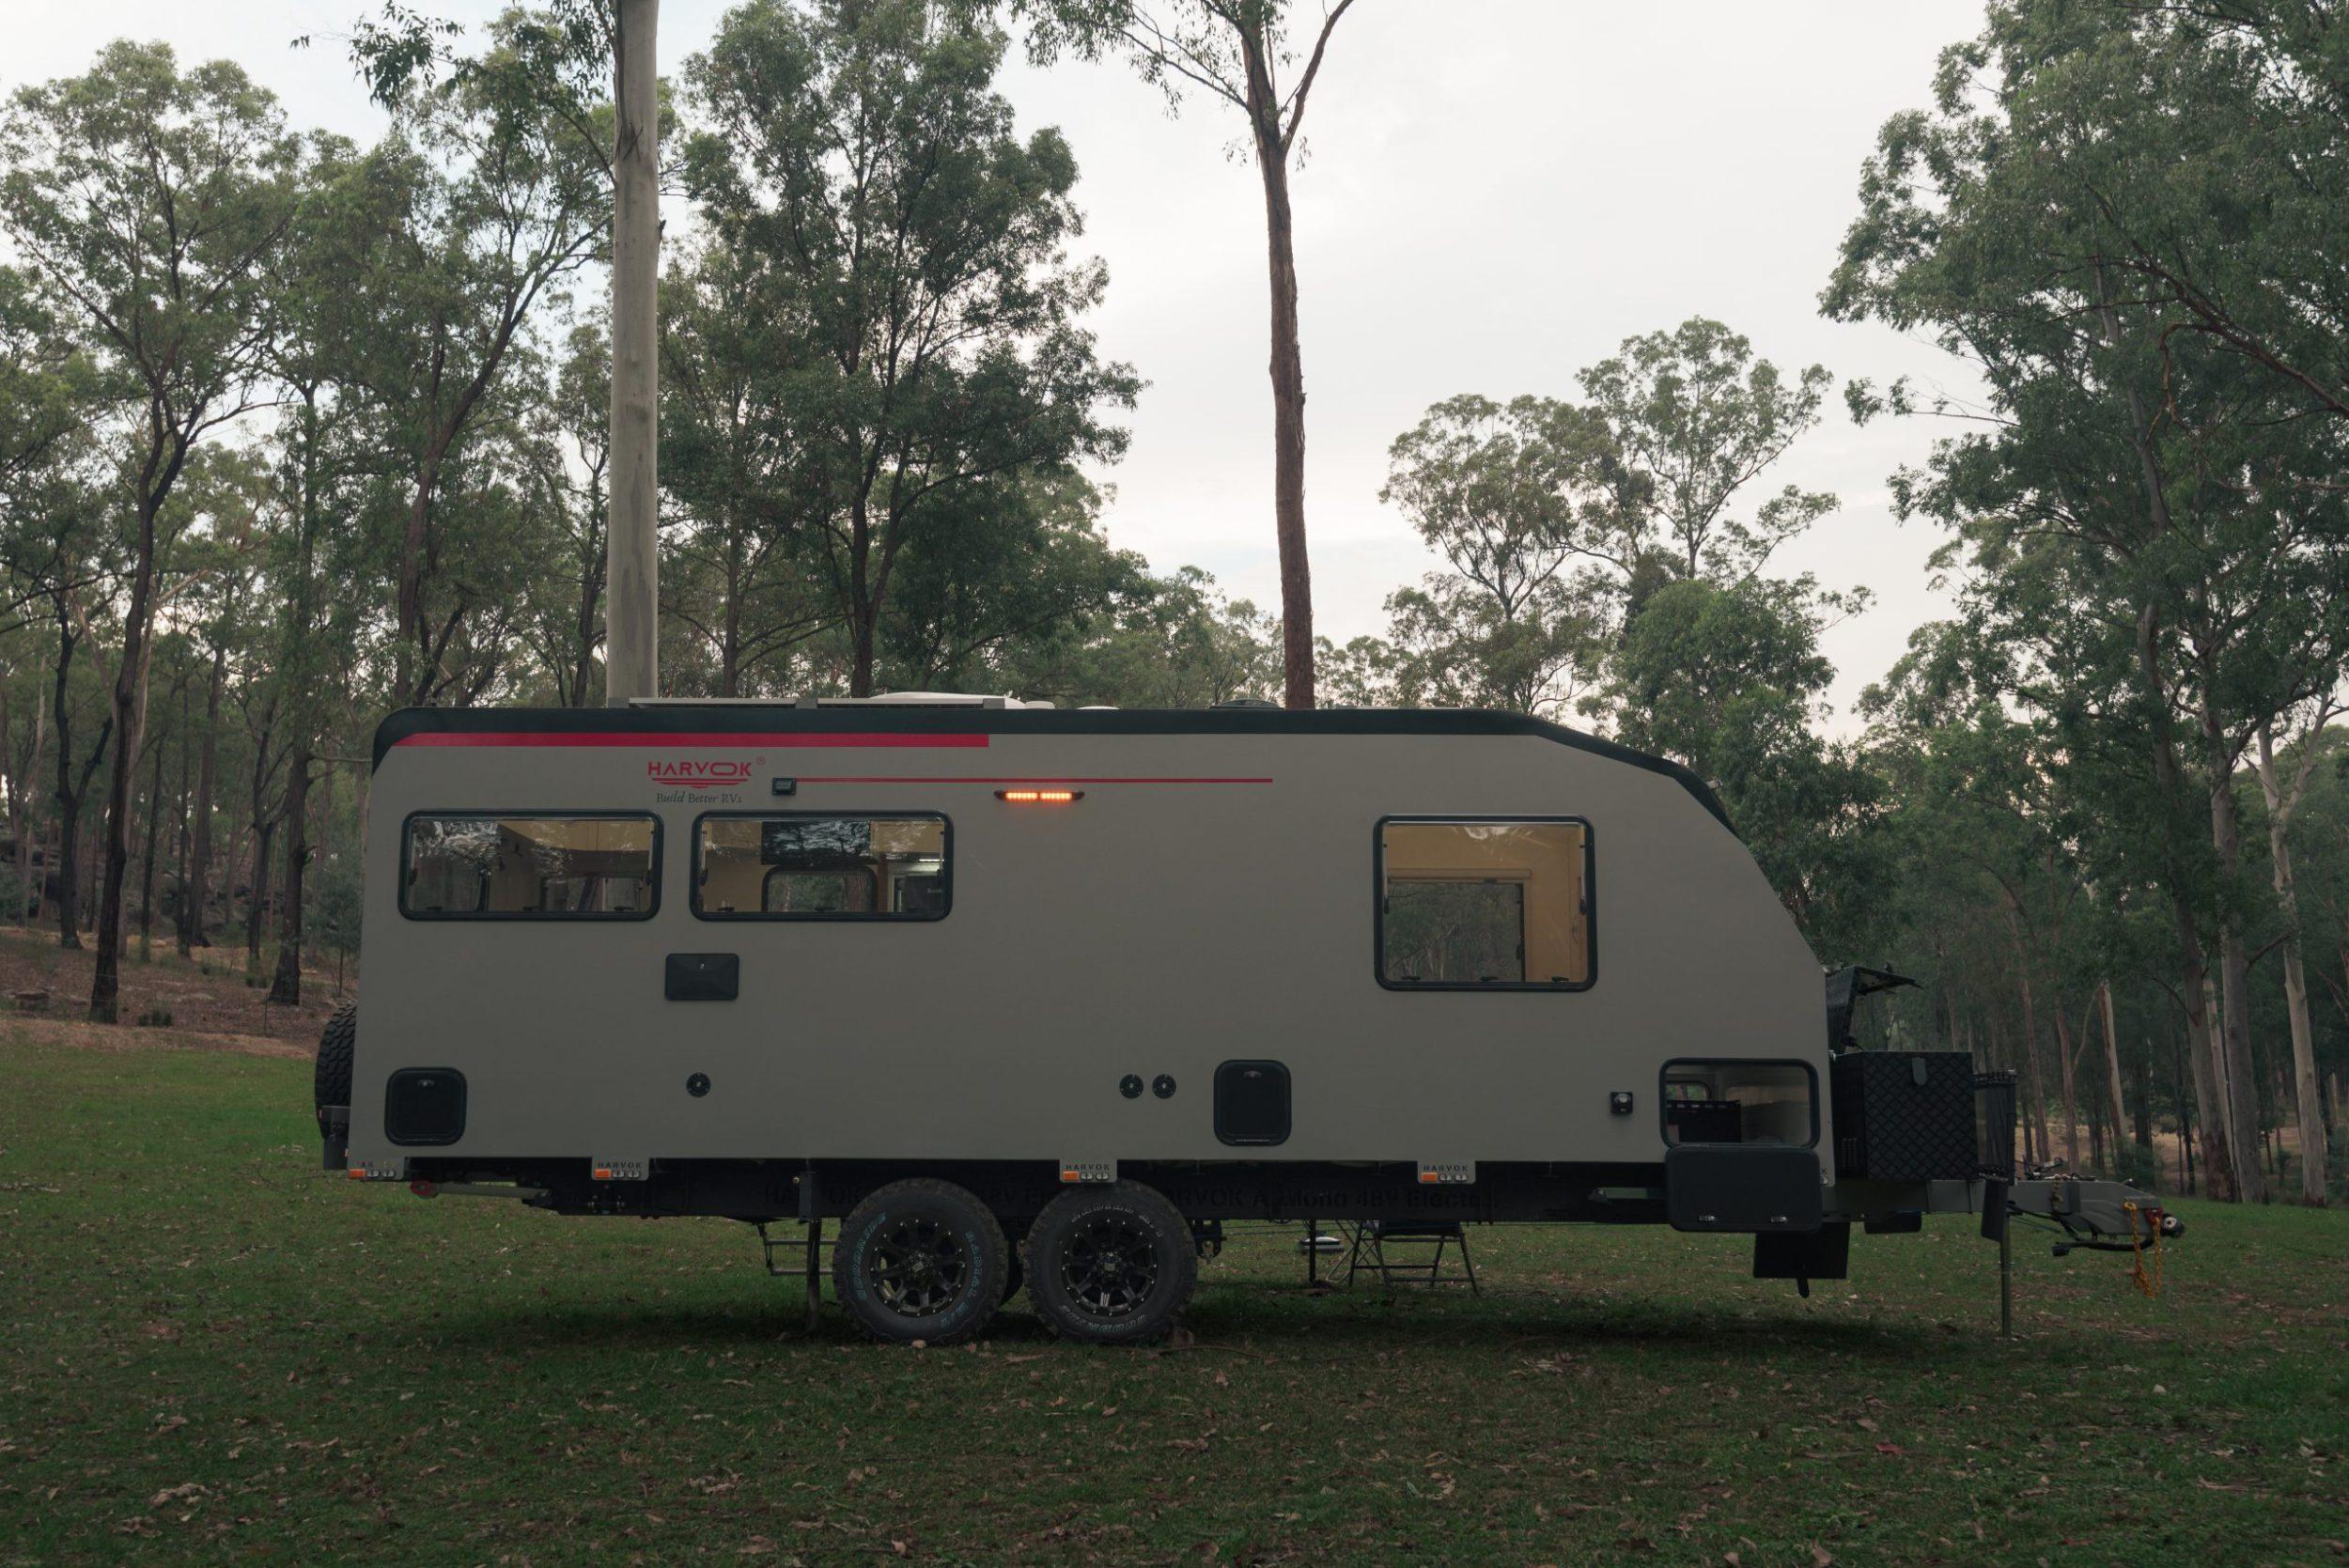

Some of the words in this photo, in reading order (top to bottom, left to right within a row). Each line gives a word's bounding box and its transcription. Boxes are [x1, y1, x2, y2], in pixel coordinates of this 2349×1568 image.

[647, 761, 752, 777] HARVOK
[656, 790, 685, 804] Build
[688, 792, 719, 804] Better
[722, 793, 742, 804] RVs
[1065, 1162, 1110, 1171] HARVOK
[1422, 1164, 1468, 1172] HARVOK
